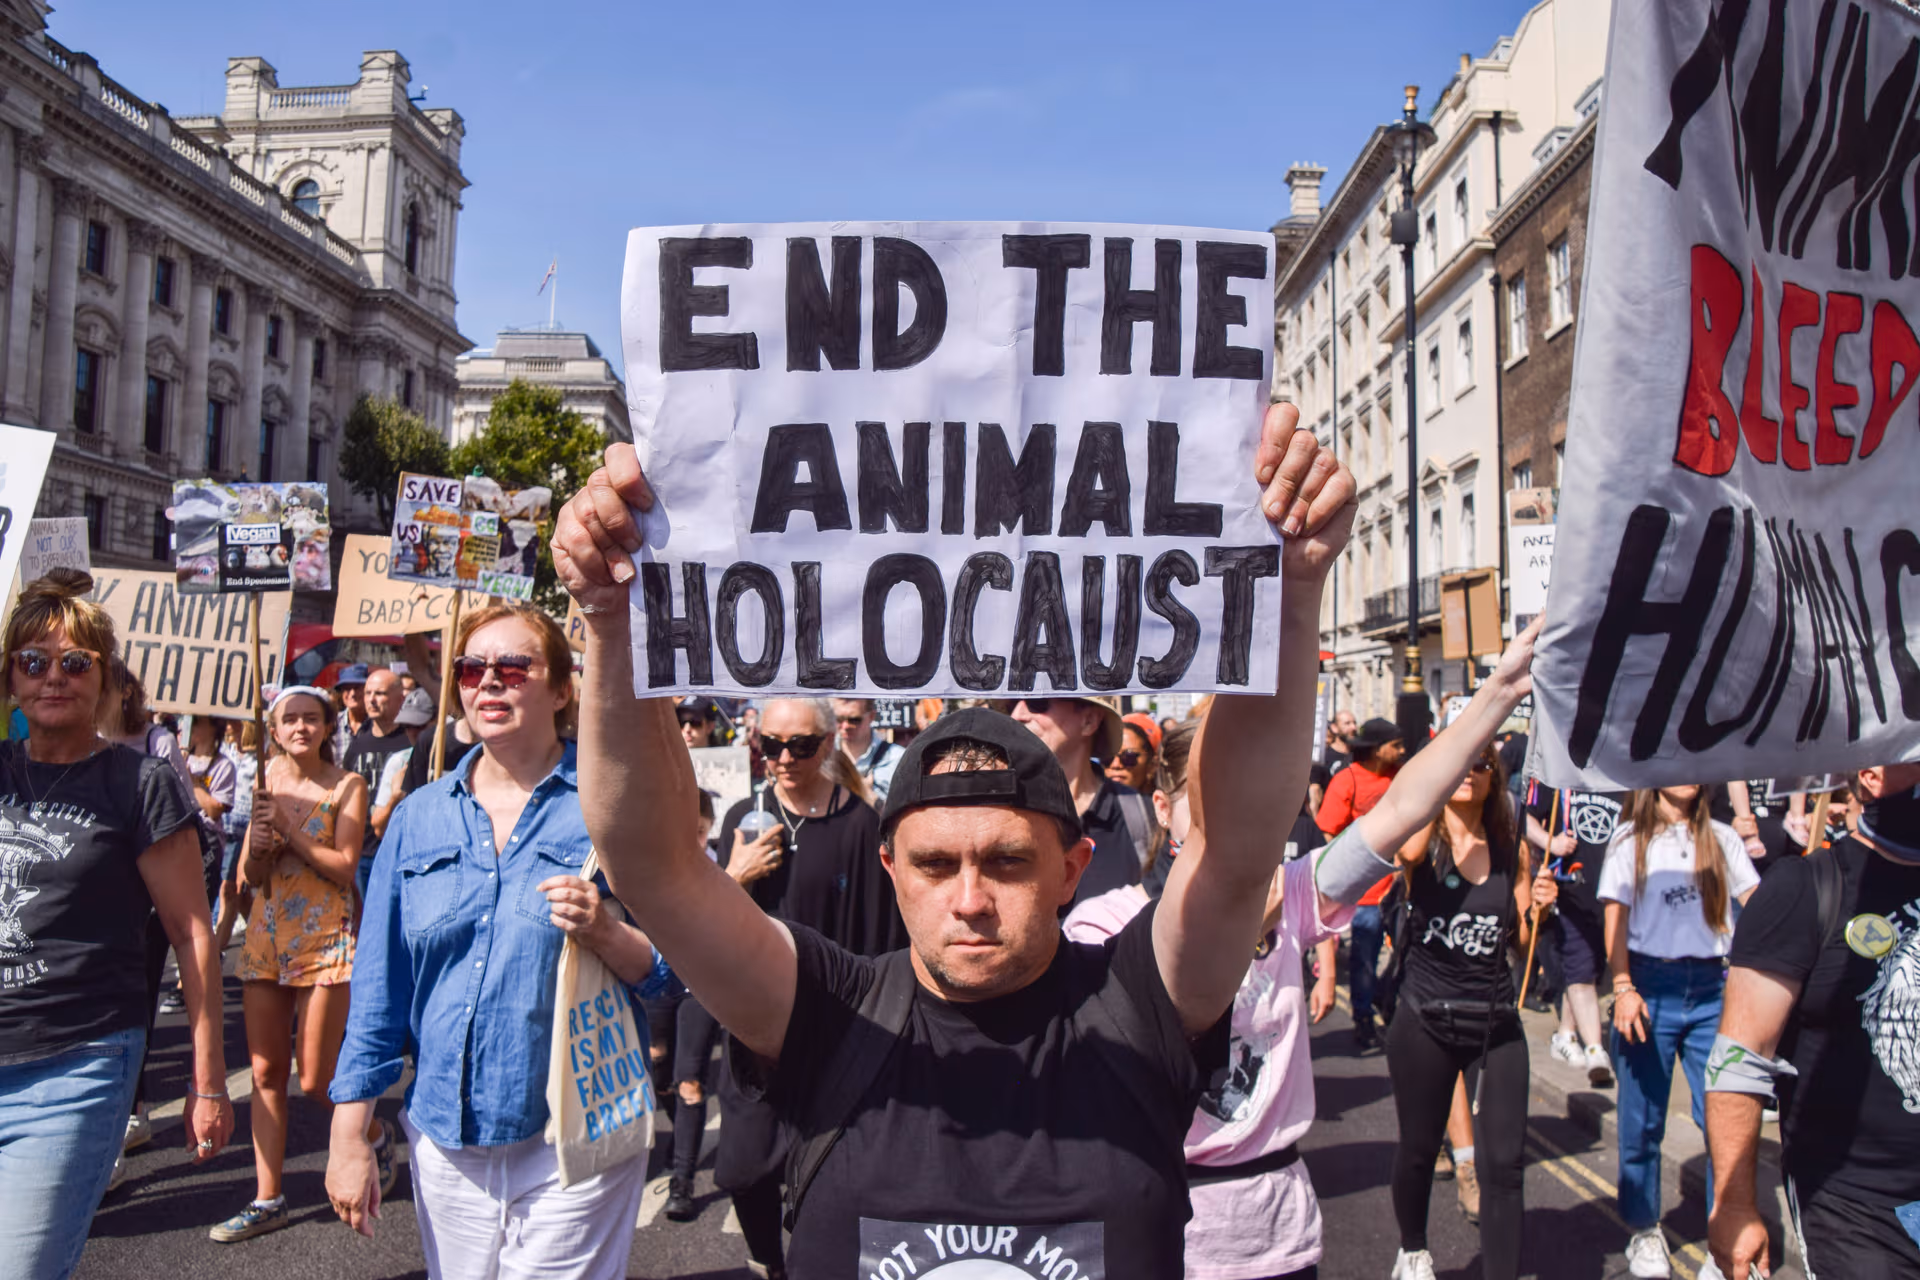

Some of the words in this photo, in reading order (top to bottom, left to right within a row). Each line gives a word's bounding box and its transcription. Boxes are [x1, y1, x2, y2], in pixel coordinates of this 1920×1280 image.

[1643, 0, 1920, 281] ANIMA
[658, 236, 949, 374] END
[1001, 233, 1268, 380] THE
[405, 480, 459, 503] SAVE
[750, 419, 1224, 539] ANIMAL
[36, 536, 53, 554] NOT
[230, 526, 277, 542] Vegan
[397, 522, 419, 543] US
[1523, 534, 1553, 548] ANI
[28, 554, 40, 570] TO
[358, 548, 389, 574] YO
[226, 577, 244, 586] End
[128, 580, 270, 645] ANIMAL
[357, 597, 420, 624] BABY
[641, 545, 1281, 691] HOLOCAUST
[569, 616, 586, 642] PL
[123, 639, 277, 711] ITATION
[47, 801, 97, 829] CYCLE
[3, 959, 49, 983] BUSE
[569, 980, 632, 1039] RESCU
[570, 1037, 595, 1074] IS
[597, 1016, 627, 1060] MY
[576, 1048, 646, 1109] FAVOU
[924, 1224, 1018, 1260] YOUR
